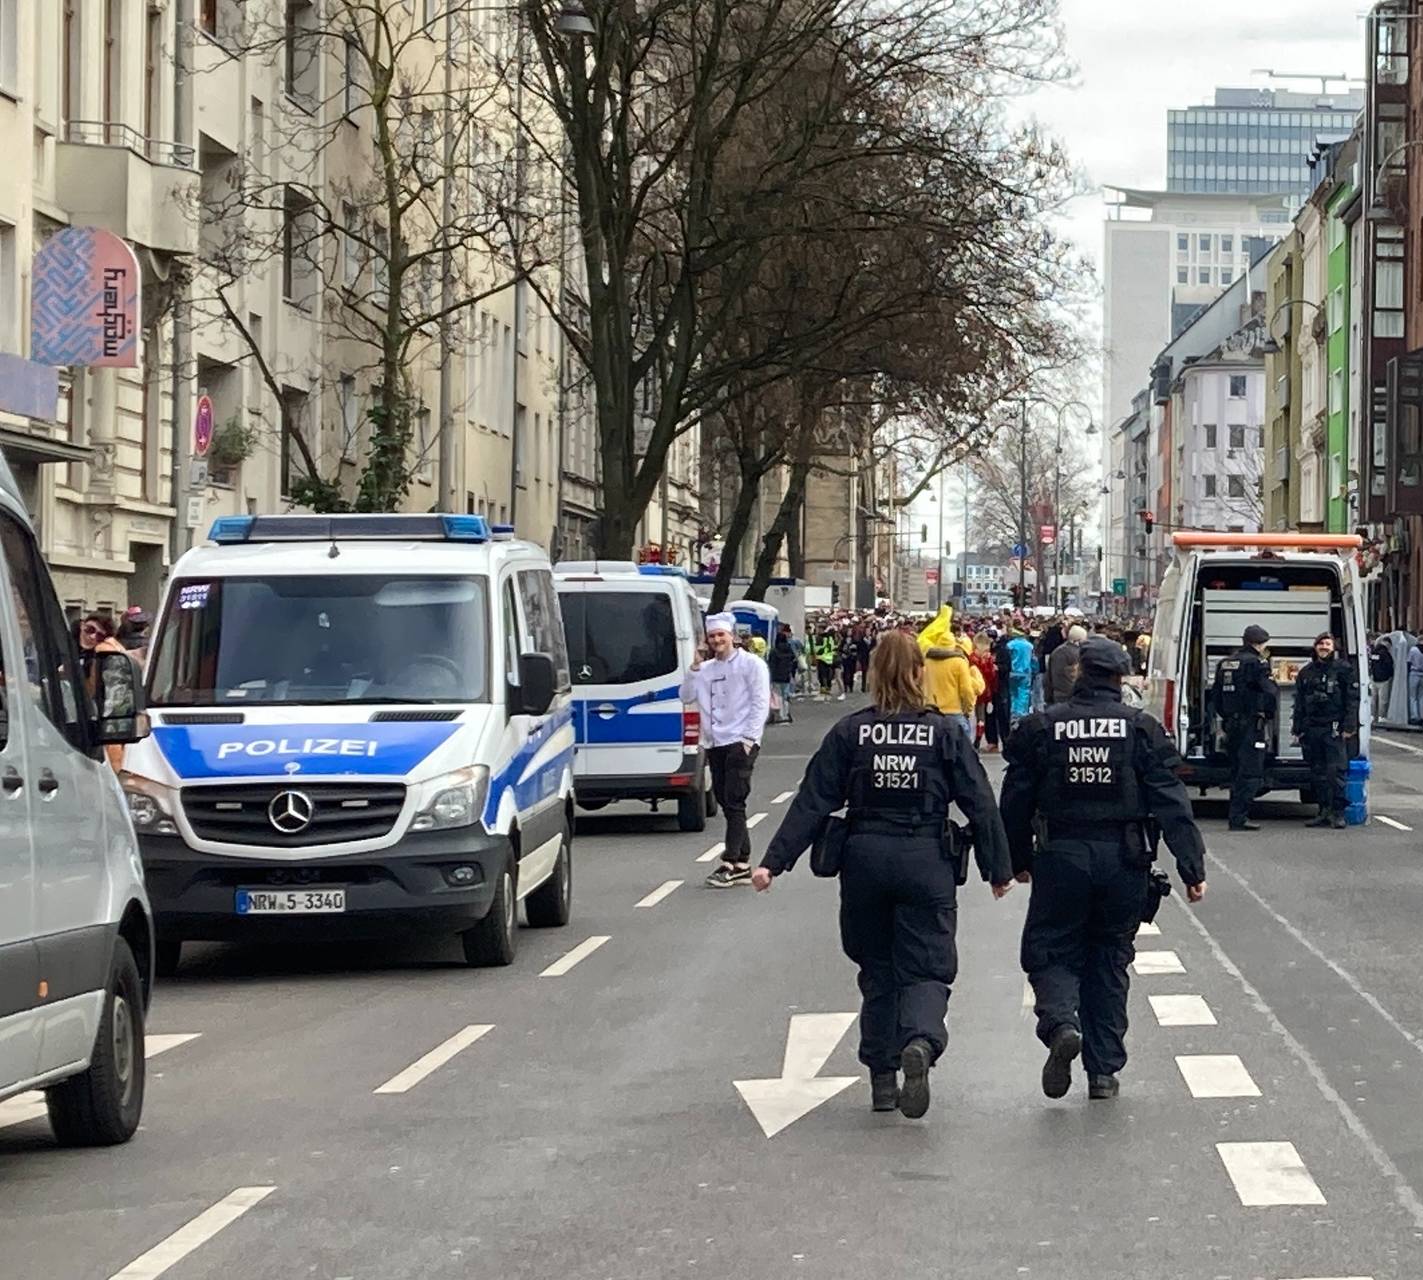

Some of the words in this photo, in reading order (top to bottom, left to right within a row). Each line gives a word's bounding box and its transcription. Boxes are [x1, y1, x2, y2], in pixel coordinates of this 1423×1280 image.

[858, 723, 934, 746] POLIZEI
[1054, 718, 1127, 740] POLIZEI
[217, 738, 378, 759] POLIZEI
[1068, 746, 1111, 763] NRW
[873, 754, 917, 771] NRW
[873, 772, 918, 789] 31521
[1068, 766, 1112, 783] 31512
[247, 894, 277, 910] NRW
[287, 893, 343, 910] 5-3340
